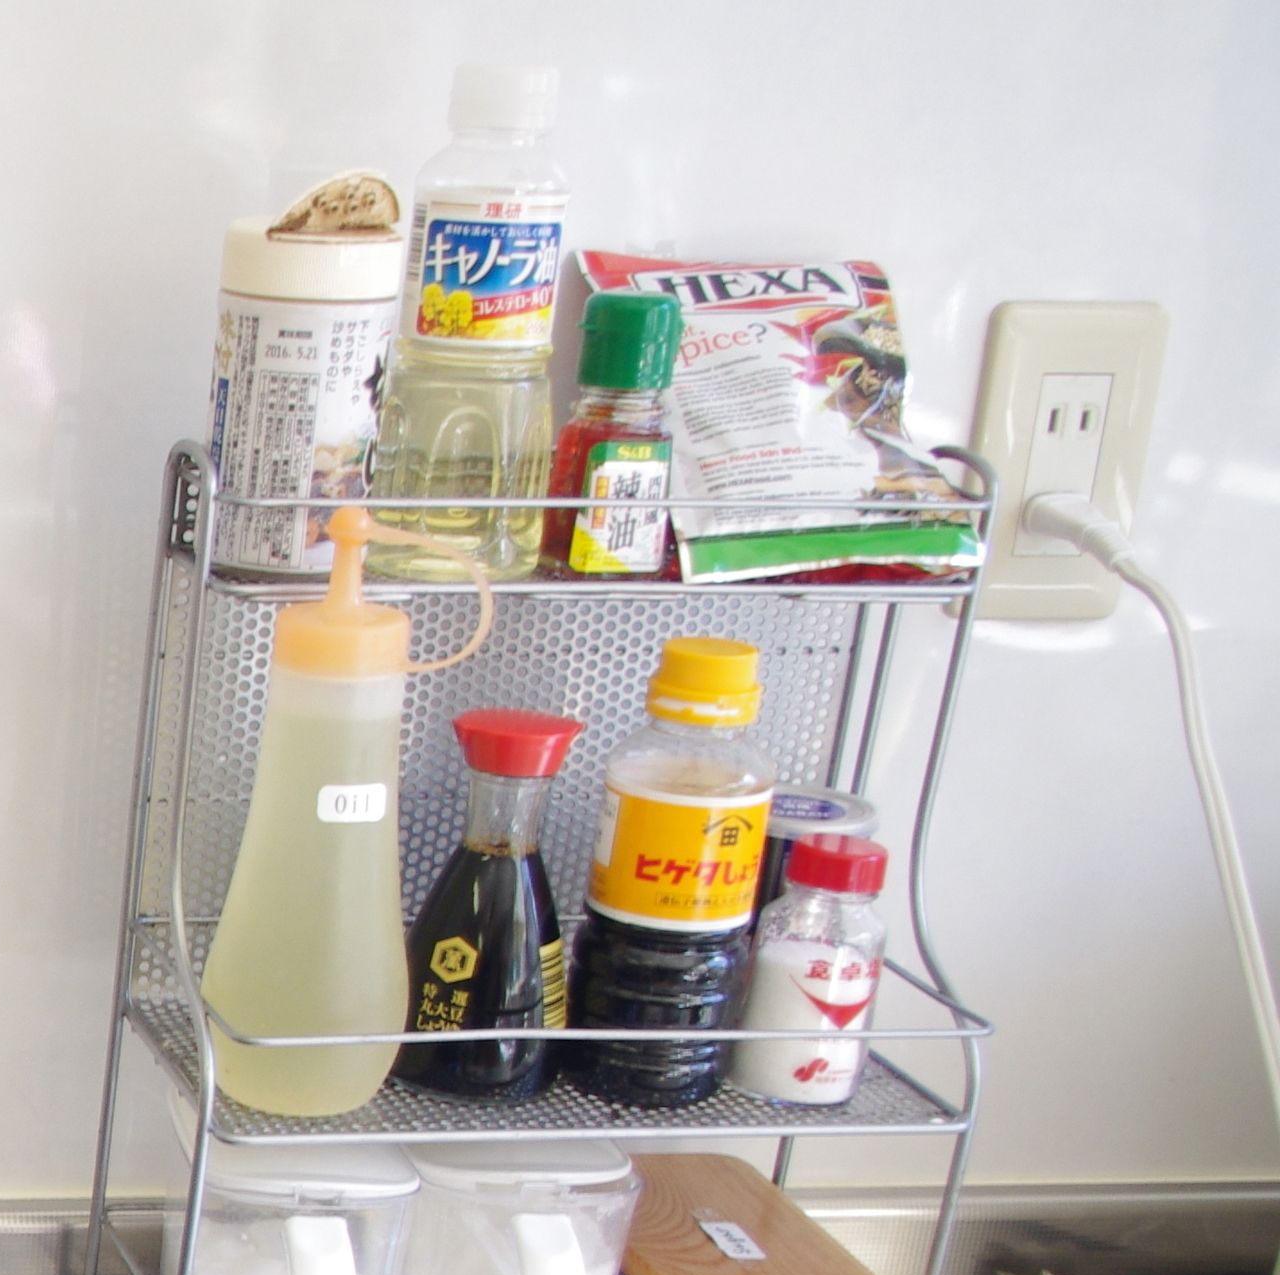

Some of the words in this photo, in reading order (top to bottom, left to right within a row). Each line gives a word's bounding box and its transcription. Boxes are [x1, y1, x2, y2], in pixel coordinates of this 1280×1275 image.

[484, 202, 523, 219] 理研
[425, 232, 558, 286] キャノーラ油
[657, 267, 847, 304] HEXA
[264, 343, 292, 360] 2016.
[341, 320, 357, 378] サラダや
[679, 322, 768, 368] pice?
[334, 793, 370, 815] Oil
